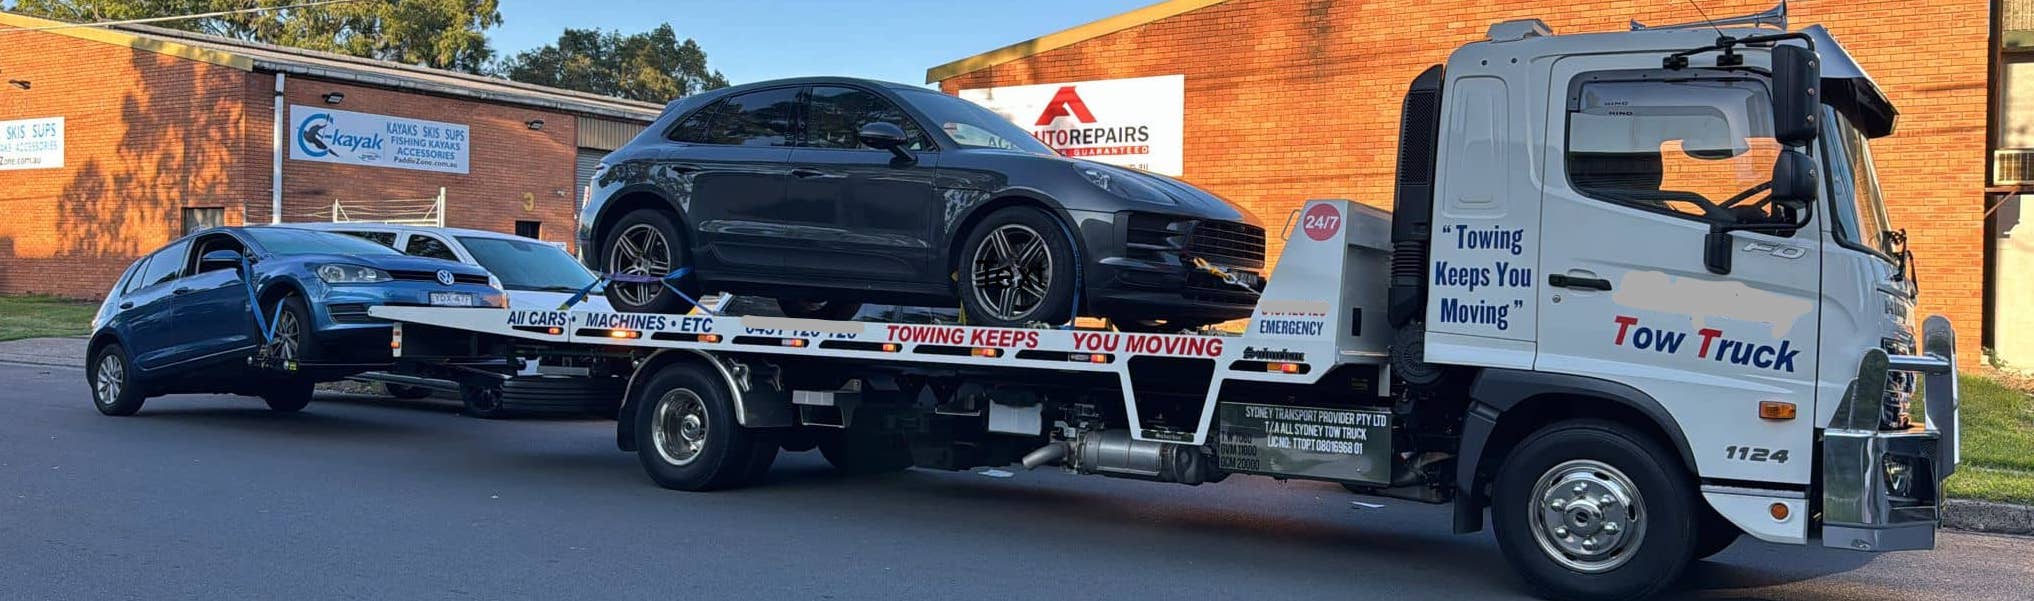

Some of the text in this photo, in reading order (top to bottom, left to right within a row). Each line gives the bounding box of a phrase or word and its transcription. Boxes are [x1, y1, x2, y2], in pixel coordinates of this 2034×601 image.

[6, 122, 56, 140] SKIS SUPS
[386, 121, 465, 141] KAYAKS SKIS SUPS
[1034, 126, 1149, 146] UTOREPAIRS
[391, 136, 461, 151] FISHING KAYAKS
[1073, 147, 1148, 156] GUARANTEED
[397, 147, 455, 160] ACCESSORIES
[523, 191, 535, 212] 3
[1305, 215, 1339, 229] 24/7
[1435, 261, 1531, 292] Keeps You
[507, 311, 713, 332] All CARS MACHINES ETC
[1260, 319, 1324, 335] EMERGENCY
[887, 325, 1223, 357] TOWING KEEPS YOU MOVING
[1614, 315, 1800, 373] Tow Truck
[1246, 406, 1387, 427] SYDNEY TRANSPORT PROVIDER PTY LTD
[1294, 423, 1323, 437] SYDNEY
[1325, 425, 1340, 438] TOW
[1342, 427, 1367, 440] TRUCK
[1726, 445, 1789, 464] 1124
